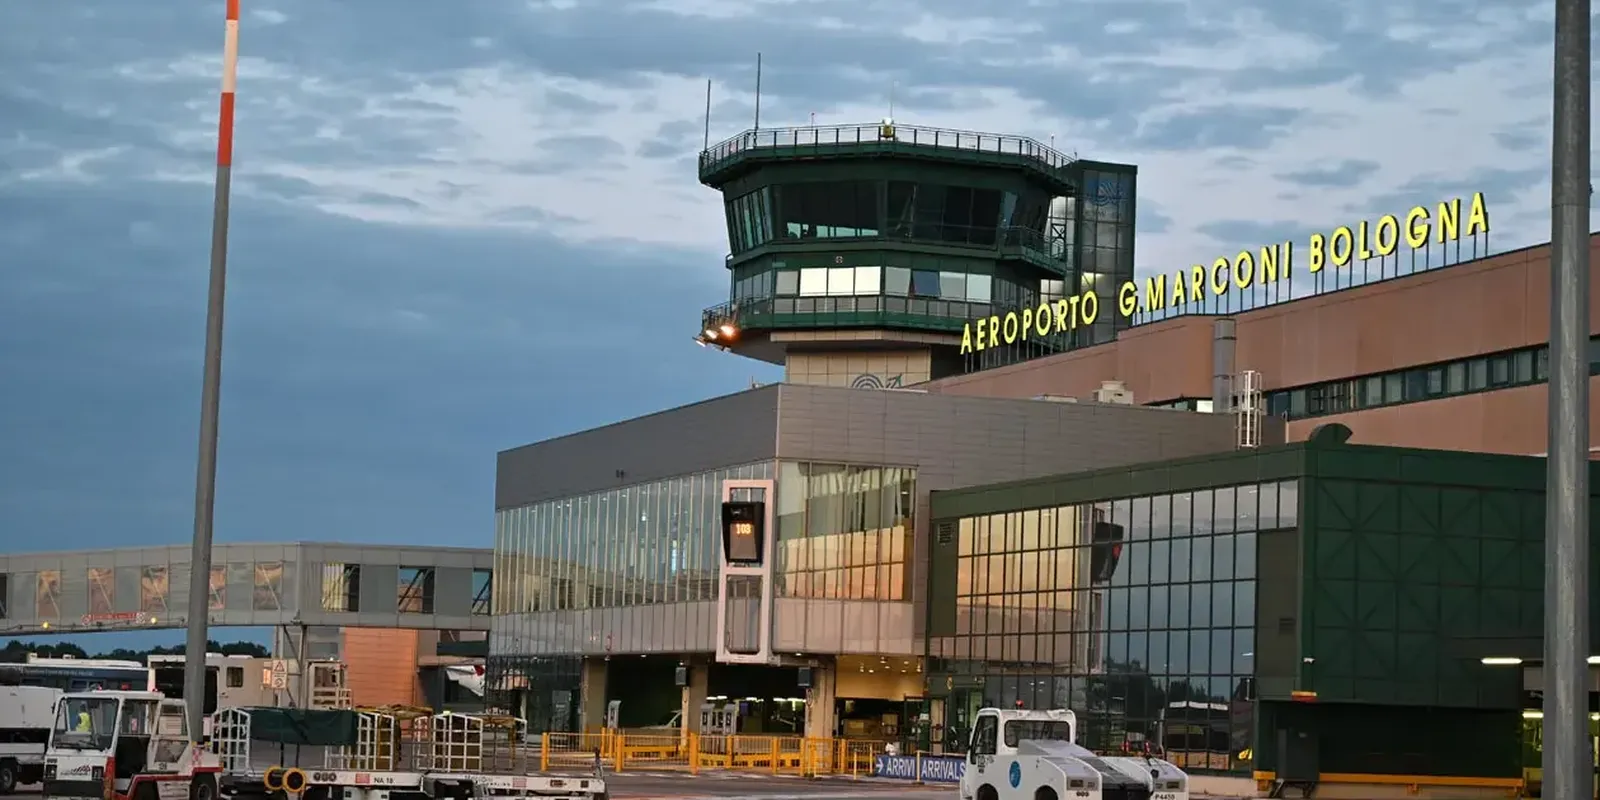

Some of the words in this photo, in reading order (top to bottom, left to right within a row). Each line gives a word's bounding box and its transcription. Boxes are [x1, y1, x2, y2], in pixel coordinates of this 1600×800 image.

[960, 289, 1099, 355] AEROPORTO
[1119, 241, 1292, 317] G.MARCONI
[1309, 192, 1489, 273] BOLOGNA
[735, 523, 752, 535] 103
[886, 757, 915, 777] ARRIVI
[921, 760, 966, 780] ARRIVALS
